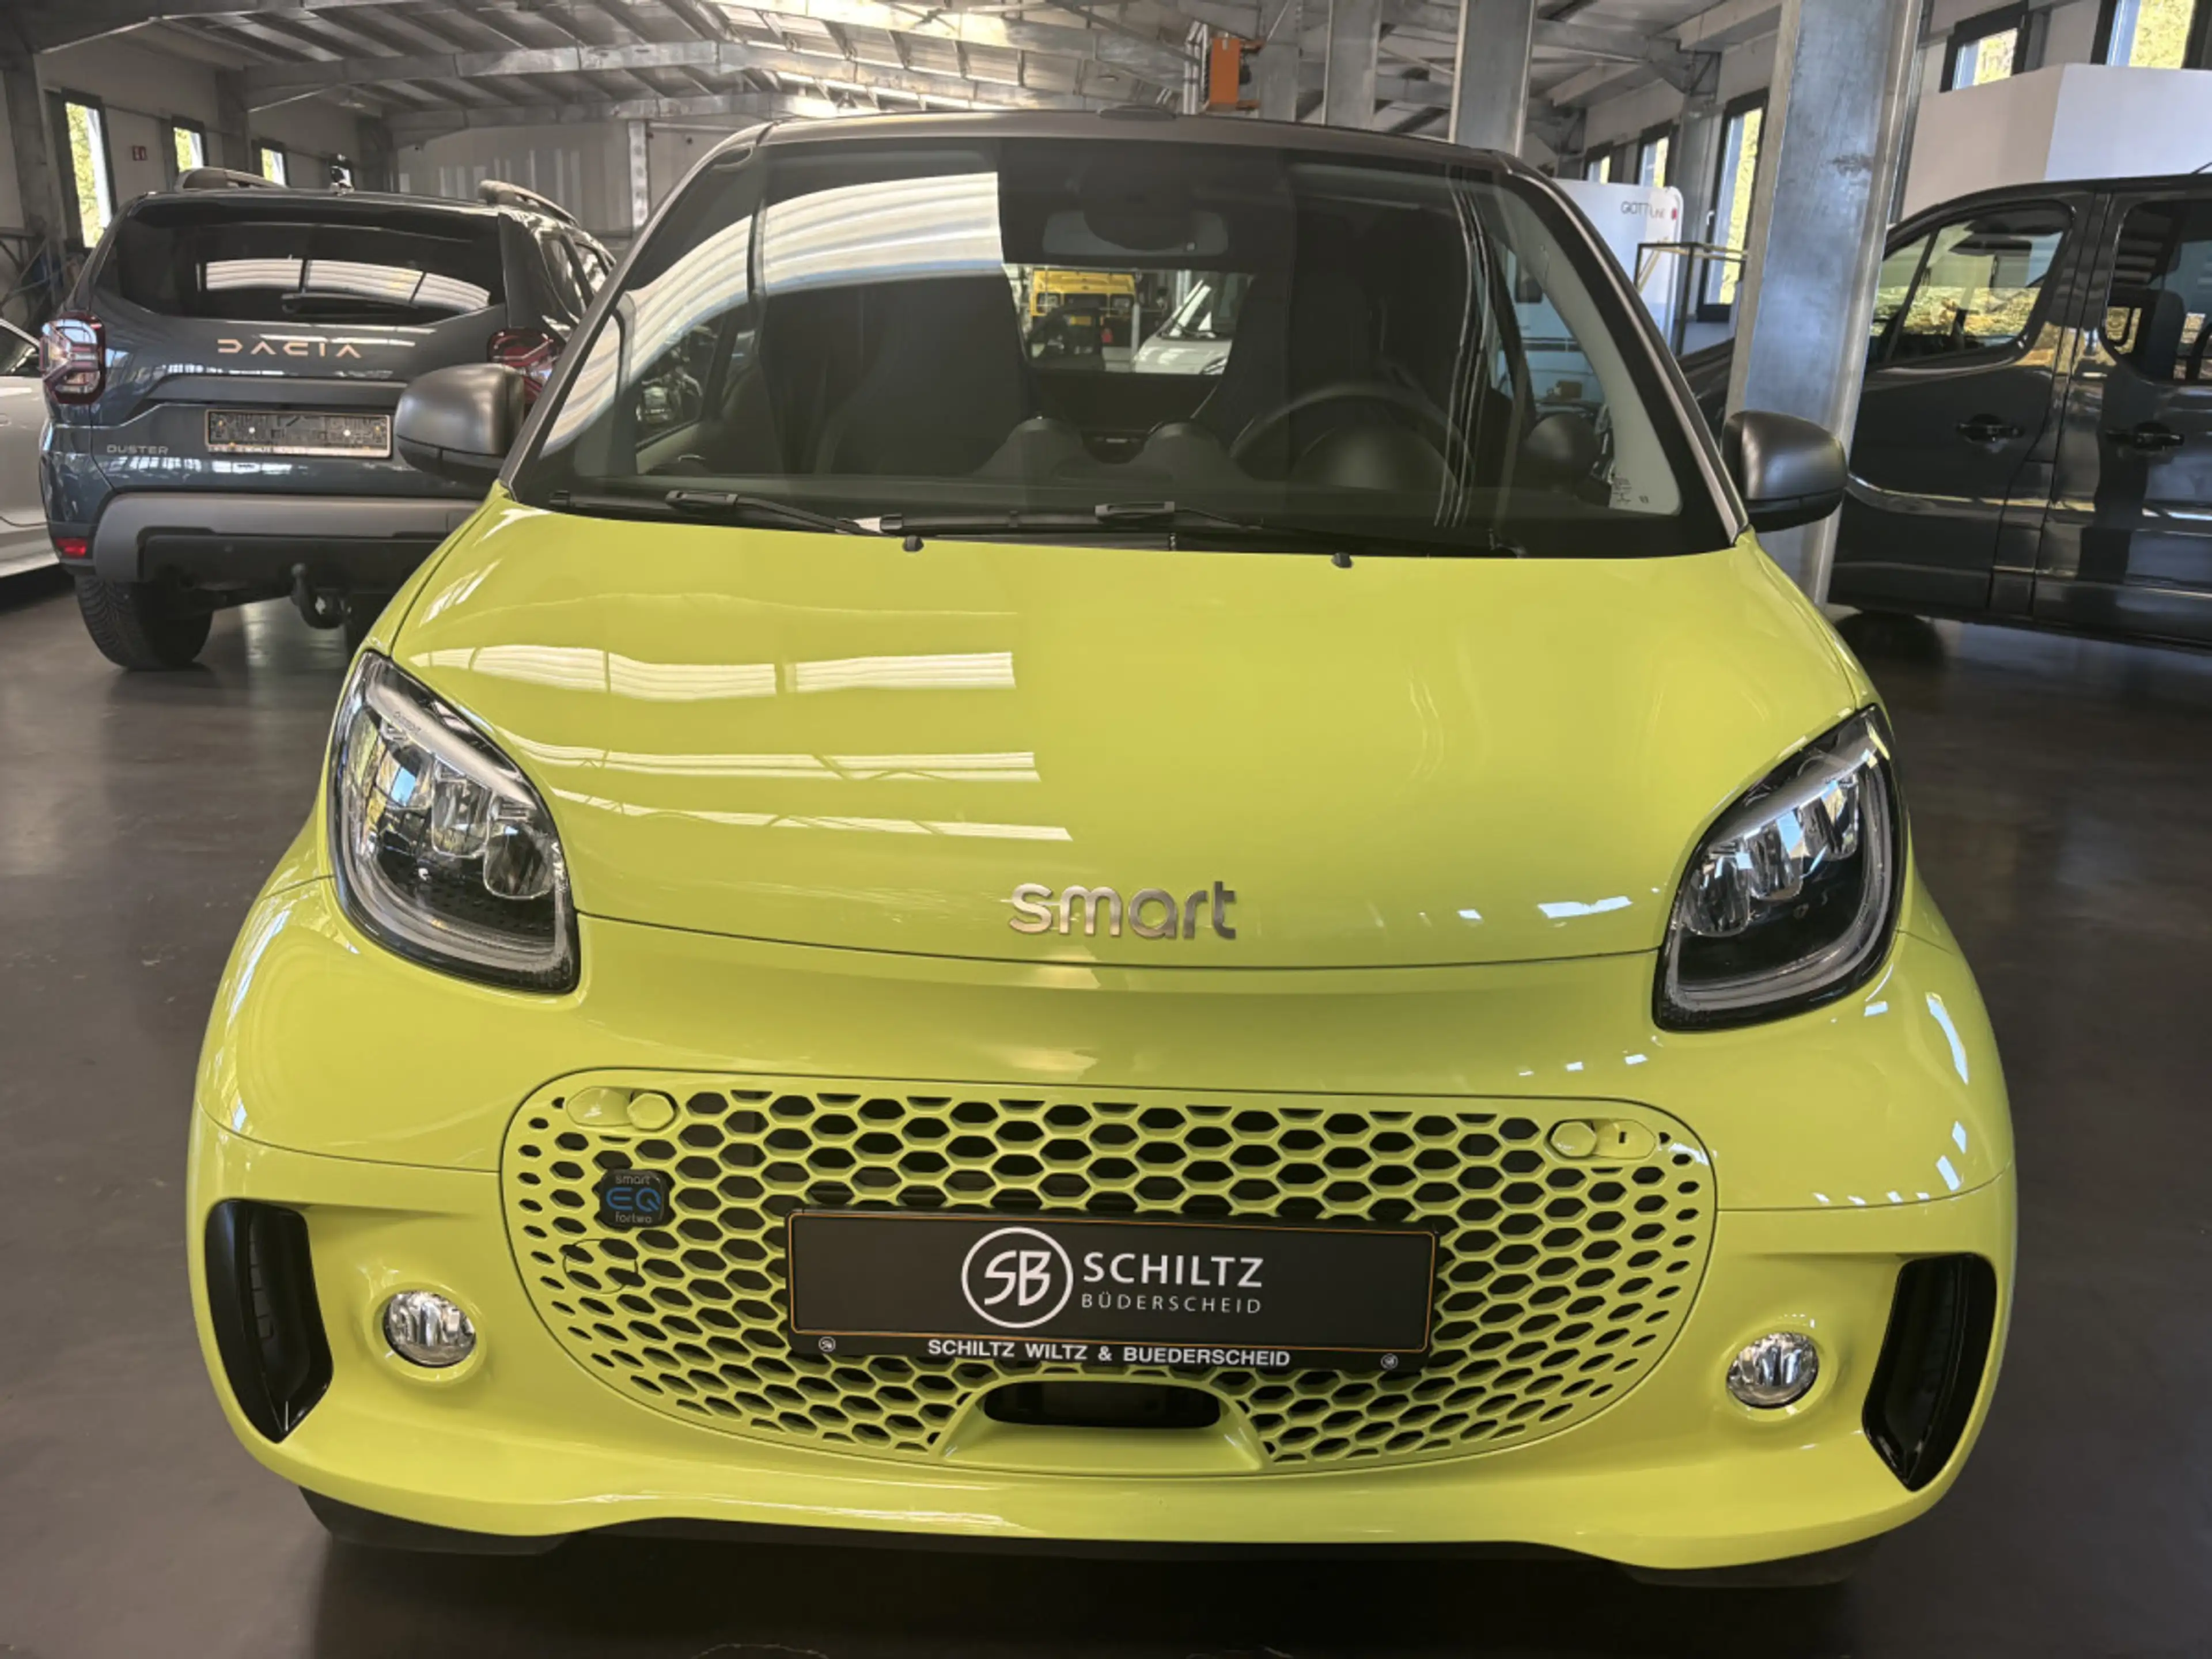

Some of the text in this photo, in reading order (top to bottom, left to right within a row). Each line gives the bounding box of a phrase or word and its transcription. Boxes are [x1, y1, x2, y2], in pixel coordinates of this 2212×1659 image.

[217, 338, 362, 358] DACIA
[107, 444, 169, 455] DUSTER
[1009, 881, 1237, 940] smart
[615, 1176, 650, 1185] smart
[606, 1187, 661, 1212] EQ
[615, 1211, 652, 1224] fortwo
[984, 1249, 1052, 1306] SB
[1083, 1252, 1264, 1288] SCHILTZ
[1081, 1291, 1262, 1313] BÜDERSCHEID
[928, 1339, 1290, 1367] SCHILTZ WILTZ & BUEDERSCHEID
